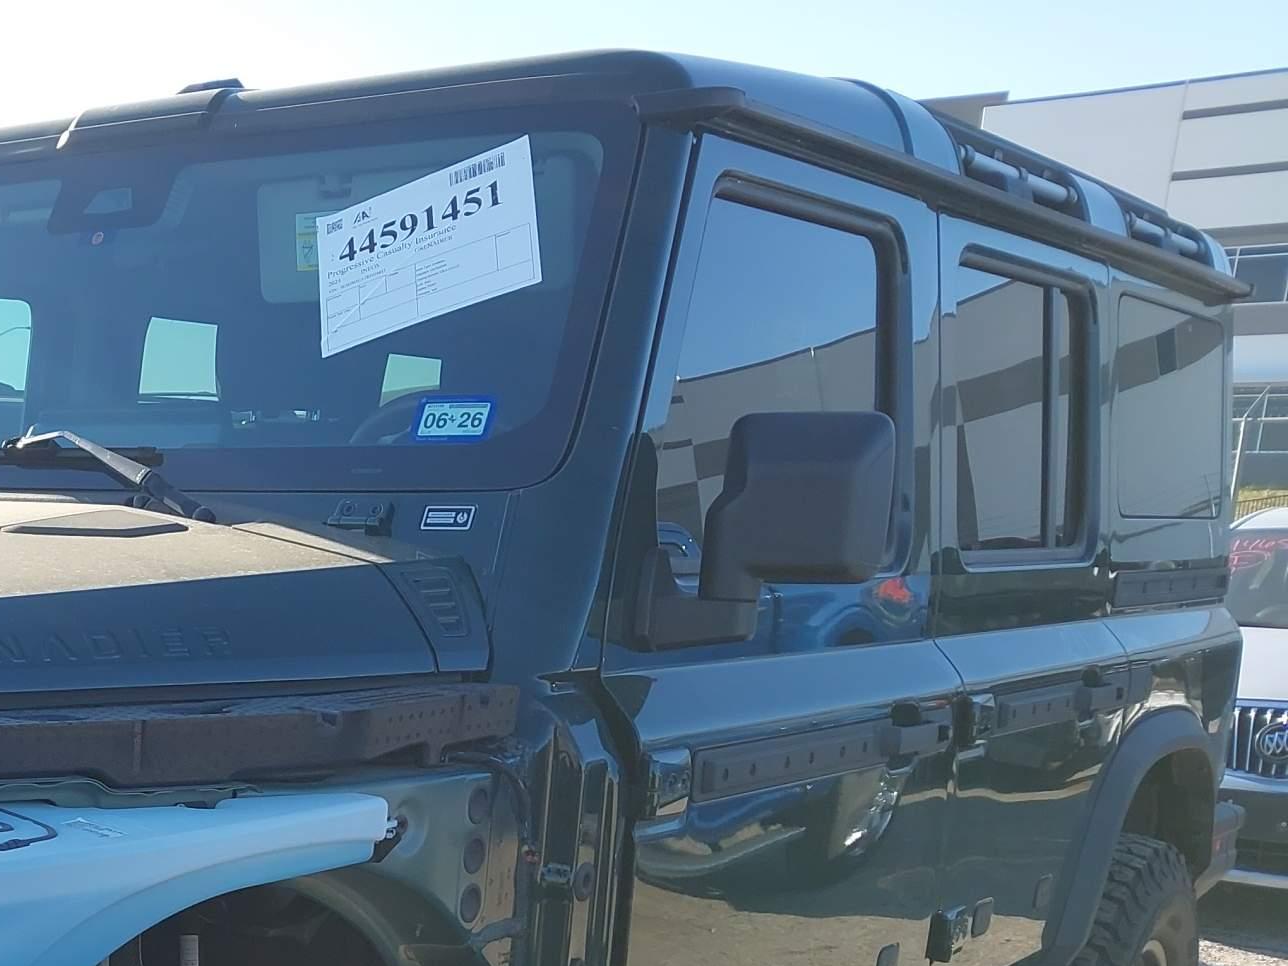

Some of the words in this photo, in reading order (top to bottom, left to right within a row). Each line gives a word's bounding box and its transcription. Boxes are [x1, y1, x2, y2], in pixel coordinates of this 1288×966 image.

[338, 179, 505, 262] 44591451
[327, 254, 375, 280] Progressive
[376, 239, 414, 262] Casualty
[415, 224, 457, 246] Insurance
[423, 412, 449, 429] 06
[457, 411, 484, 429] 26
